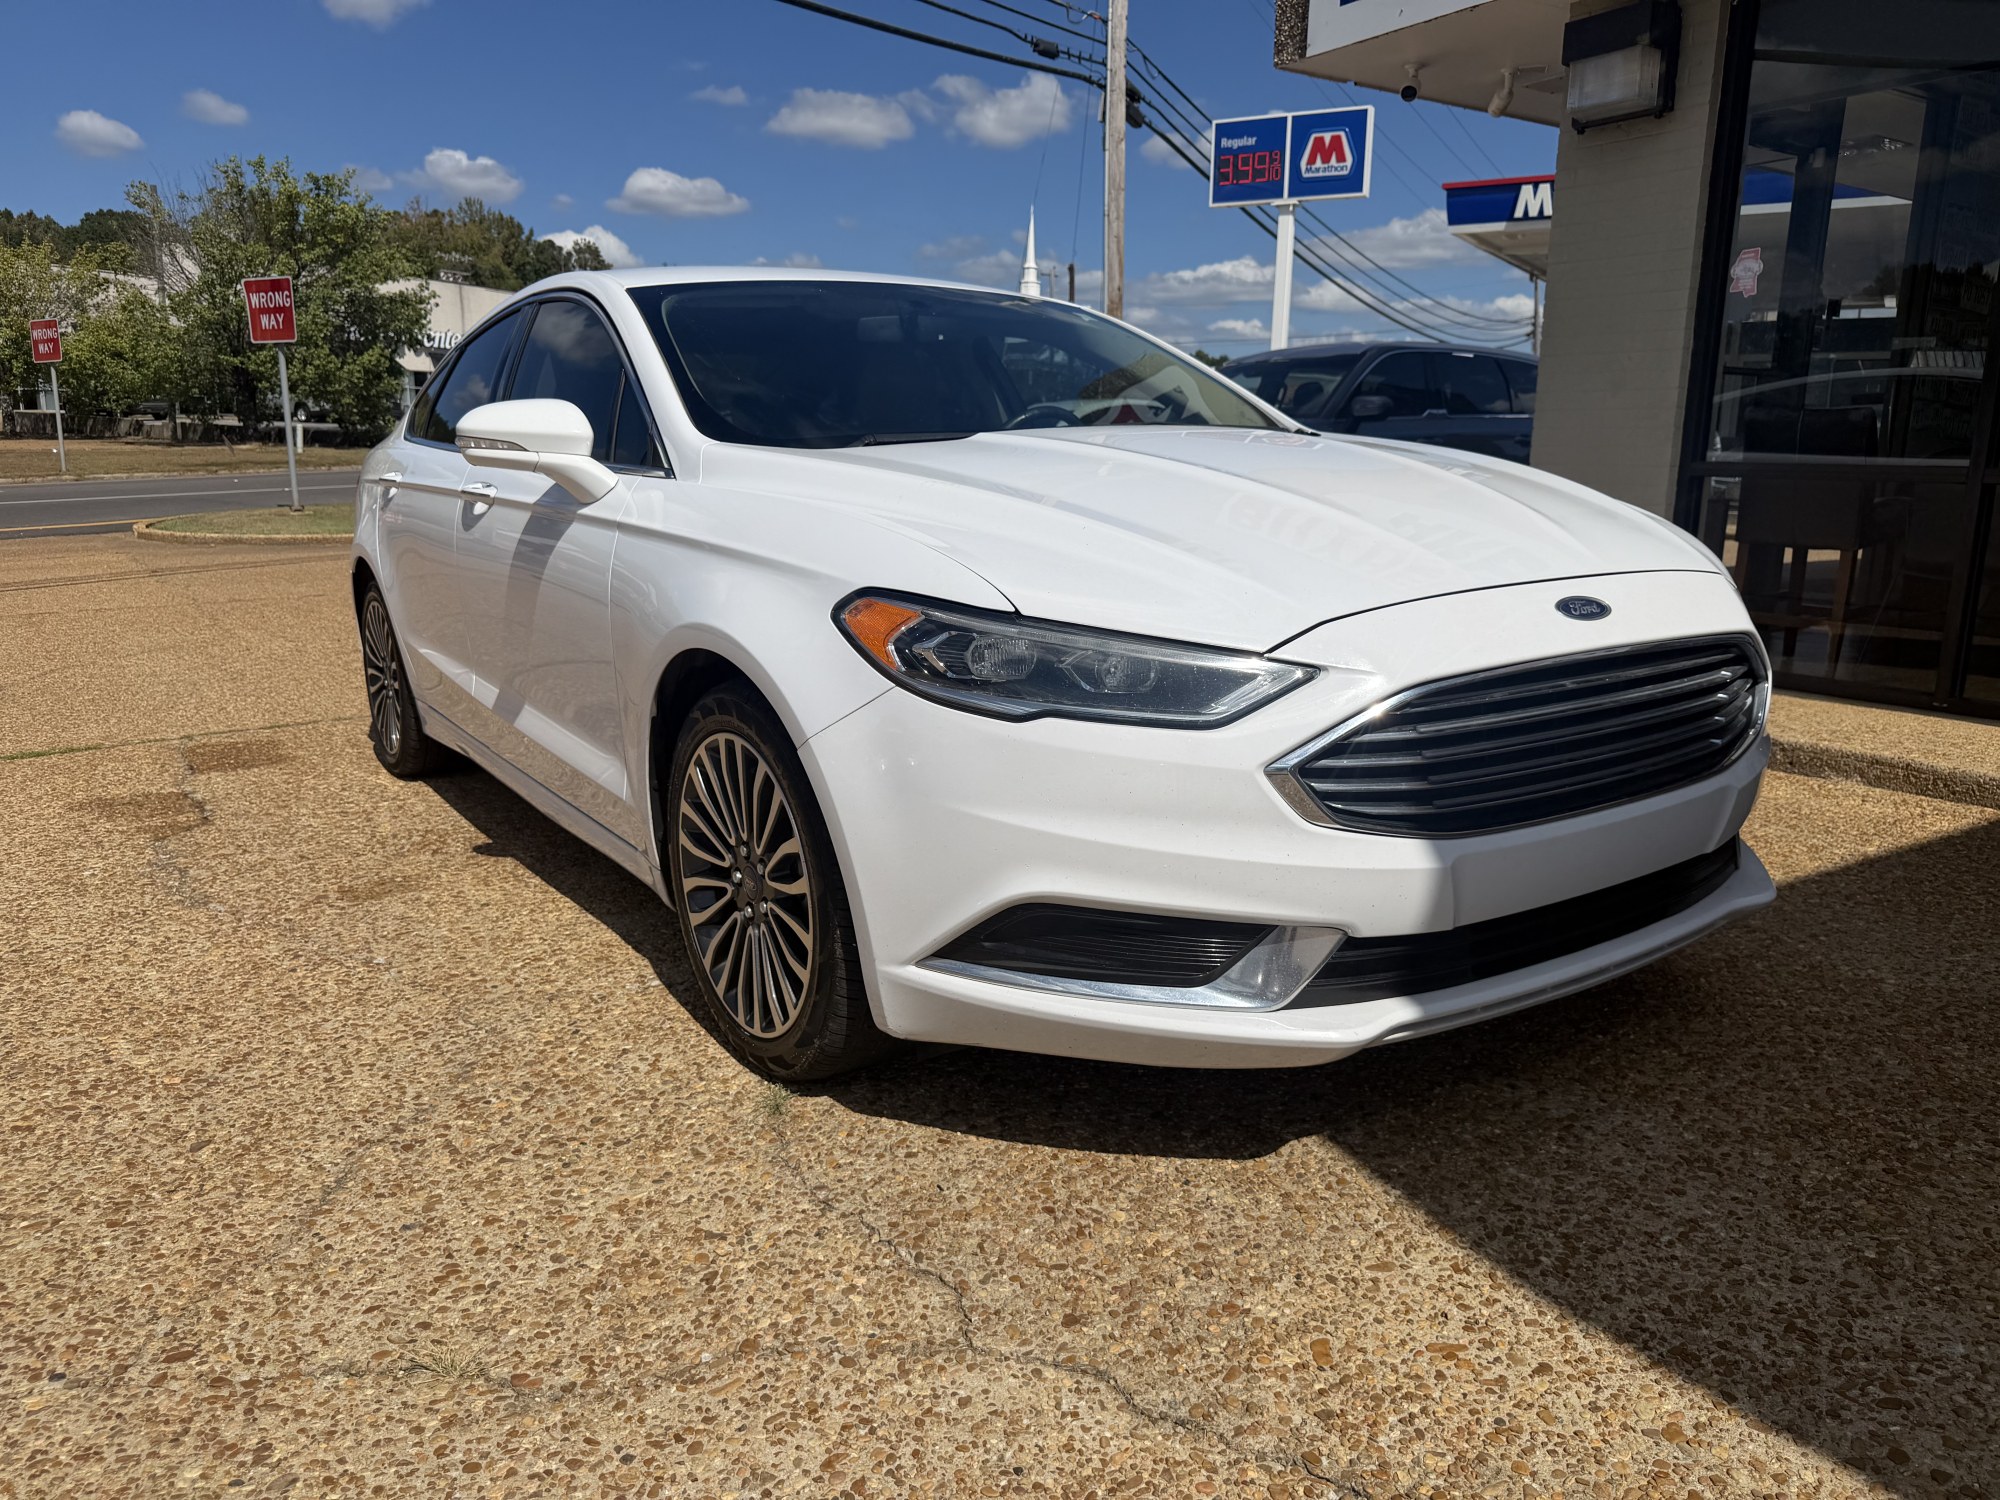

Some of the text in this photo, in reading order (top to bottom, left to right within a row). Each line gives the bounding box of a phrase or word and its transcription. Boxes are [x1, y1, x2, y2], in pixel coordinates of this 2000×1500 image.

[1221, 136, 1257, 149] Regular
[1219, 151, 1270, 186] 3.99
[1304, 164, 1348, 175] Marathon
[1513, 182, 1553, 219] M
[249, 290, 291, 309] WRONG
[260, 313, 284, 330] WAY
[32, 327, 58, 341] WRONG
[38, 342, 54, 354] WAY
[1568, 600, 1601, 615] Ford
